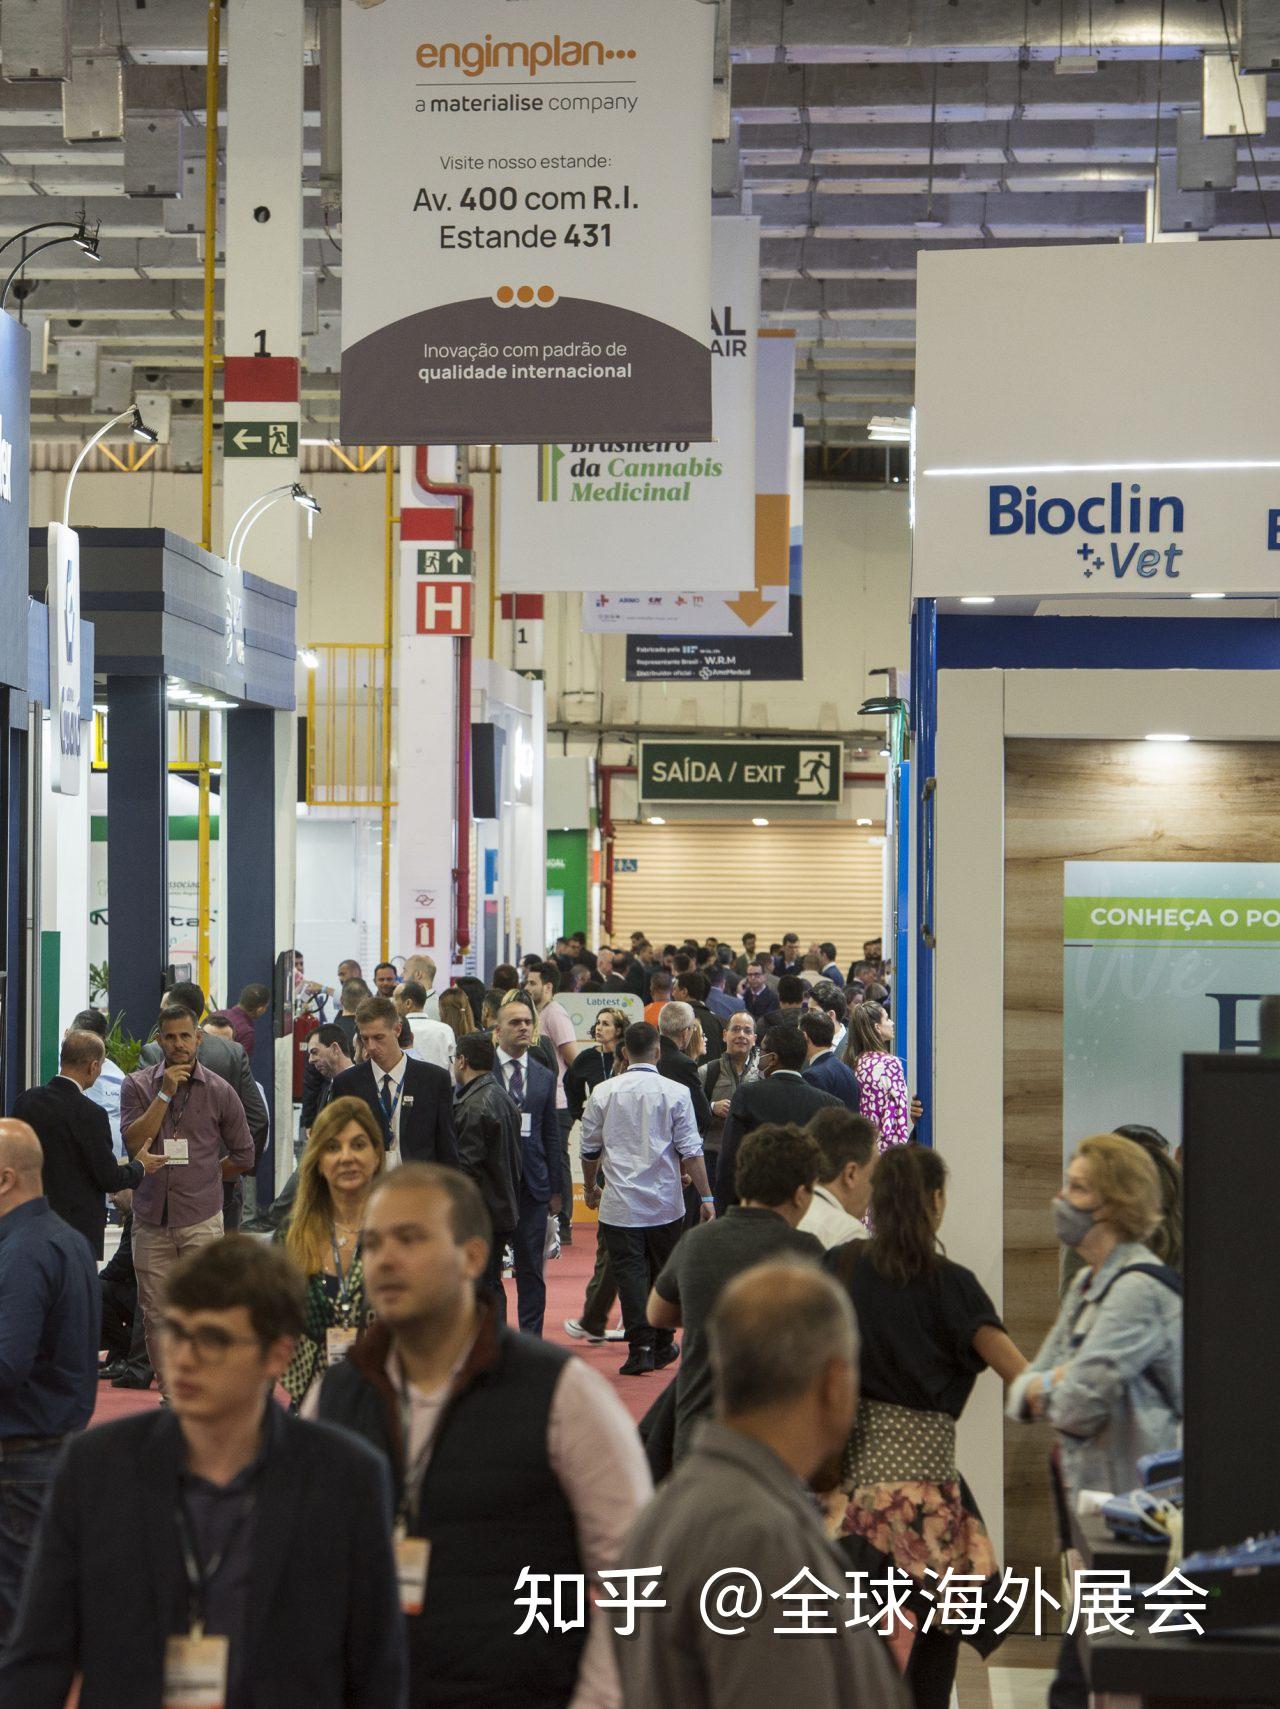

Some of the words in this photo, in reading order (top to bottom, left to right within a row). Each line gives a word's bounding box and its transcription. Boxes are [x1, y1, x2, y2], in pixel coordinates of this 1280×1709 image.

[416, 34, 605, 77] engimplan
[415, 99, 426, 113] a
[430, 94, 543, 113] materialise
[548, 95, 638, 114] company
[439, 154, 485, 170] Visite
[488, 156, 537, 170] nosso
[540, 153, 612, 170] estande:
[413, 188, 452, 213] Av.
[460, 187, 518, 211] 400
[524, 191, 586, 211] com
[593, 185, 639, 210] R.I.
[439, 224, 557, 249] Estande
[564, 223, 612, 248] 431
[253, 329, 272, 357] 1
[424, 342, 499, 361] Inovação
[503, 345, 539, 358] com
[542, 340, 601, 362] padrão
[605, 340, 627, 357] de
[418, 363, 508, 384] qualidade
[511, 362, 632, 380] internacional
[570, 458, 601, 478] da
[607, 457, 723, 478] Cannabis
[570, 481, 690, 502] Medicinal
[989, 482, 1184, 535] Bioclin
[1110, 542, 1183, 578] Vet
[425, 586, 462, 630] H
[517, 628, 528, 644] 1
[652, 756, 723, 783] SAÍDA
[727, 761, 737, 783] /
[744, 765, 786, 784] EXIT
[1090, 907, 1213, 931] CONHEÇA
[1220, 909, 1239, 927] O
